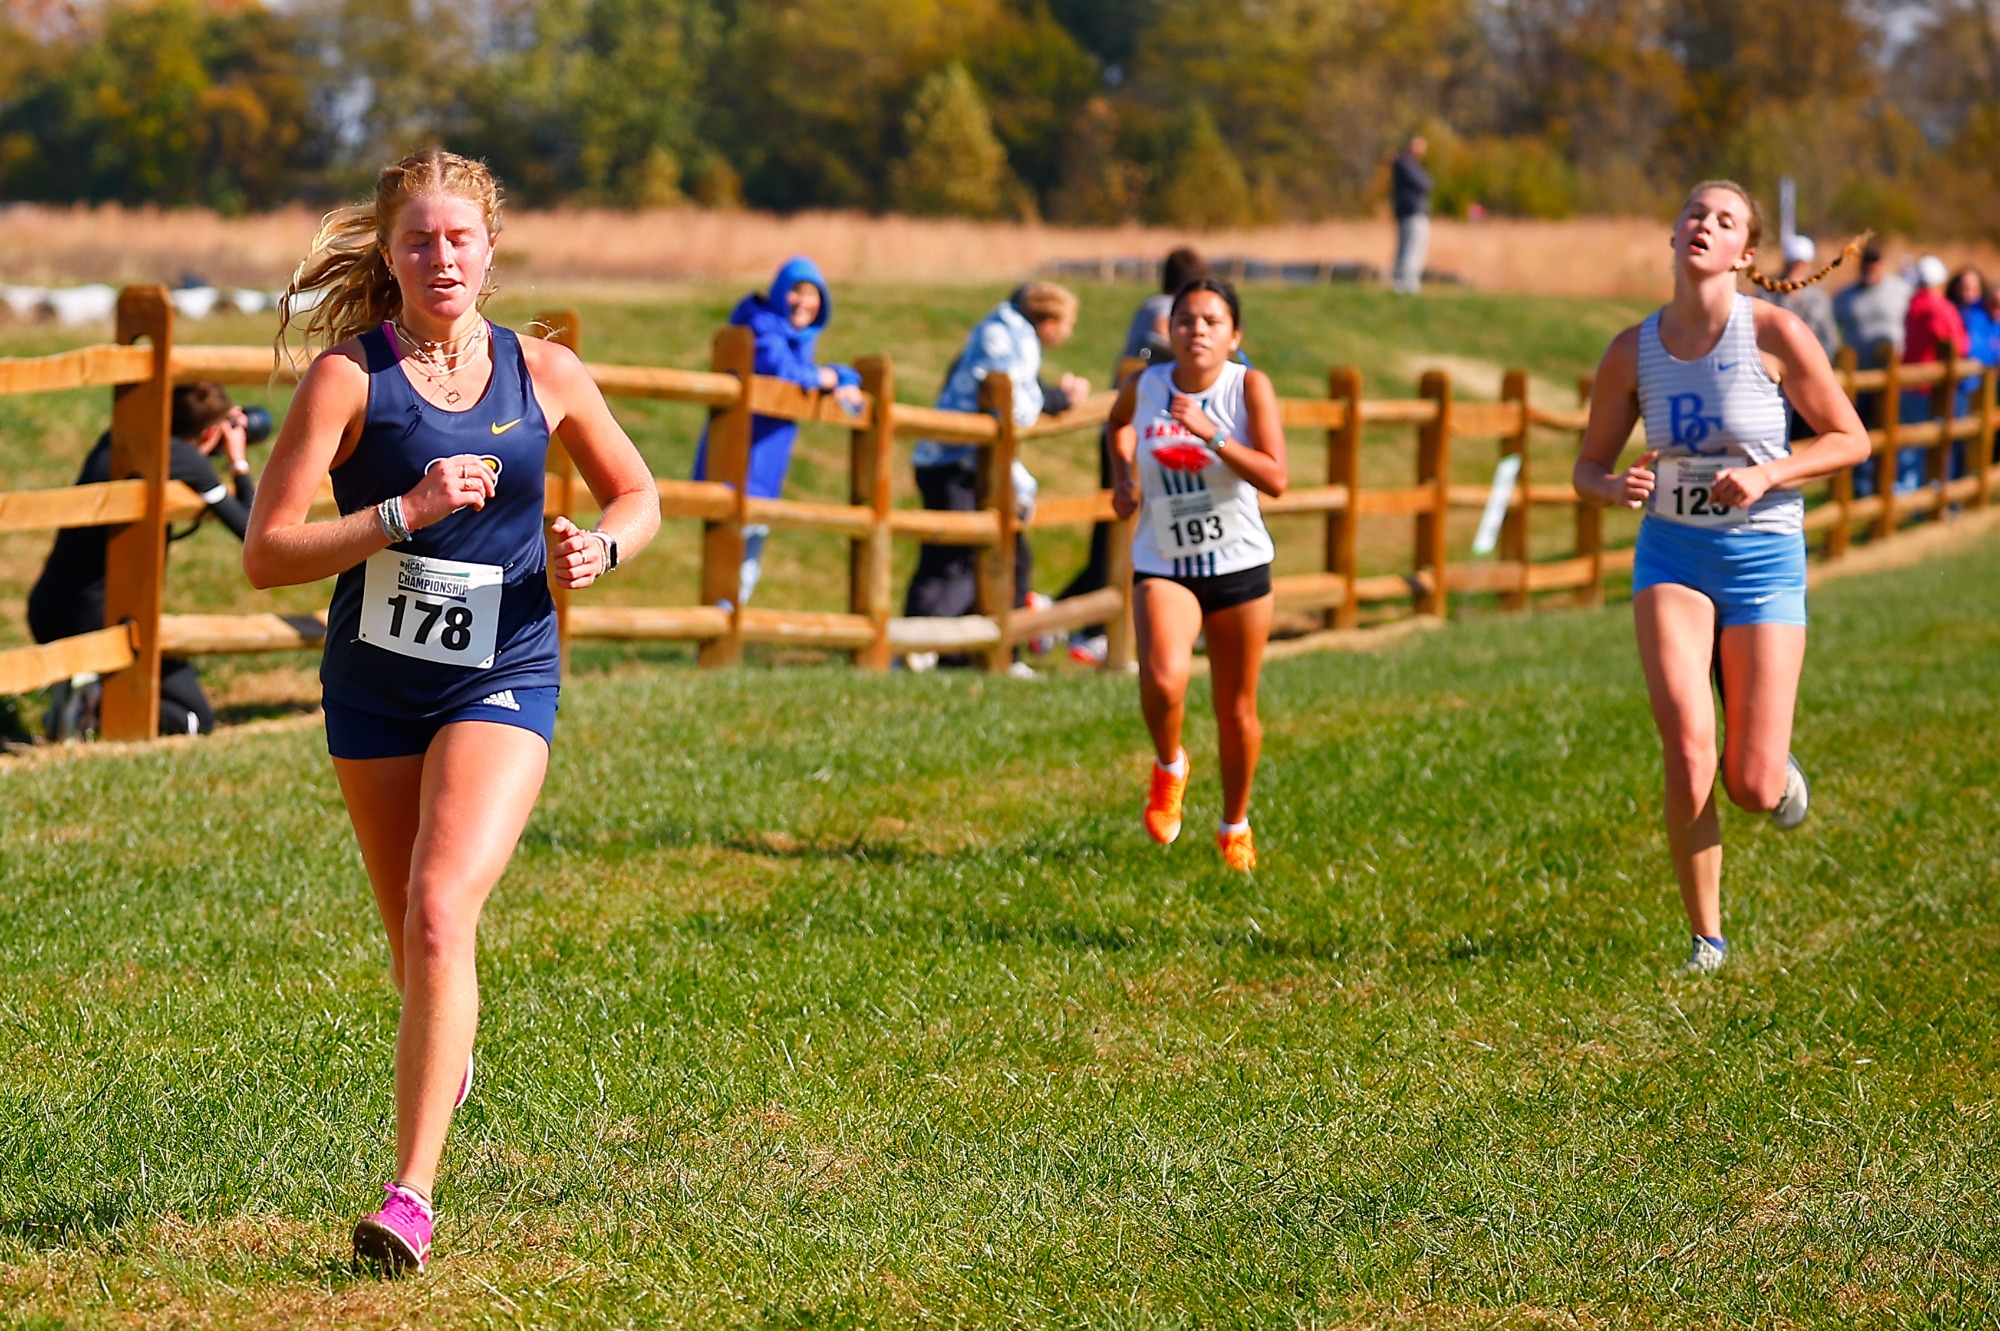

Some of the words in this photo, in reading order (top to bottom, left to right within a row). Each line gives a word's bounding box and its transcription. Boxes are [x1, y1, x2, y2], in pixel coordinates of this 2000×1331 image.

[1668, 392, 1728, 456] BC
[1170, 515, 1223, 546] 193
[404, 560, 426, 572] HCAC
[398, 571, 468, 595] CHAMPIONSHIP
[388, 594, 473, 650] 178
[483, 698, 520, 711] adidas
